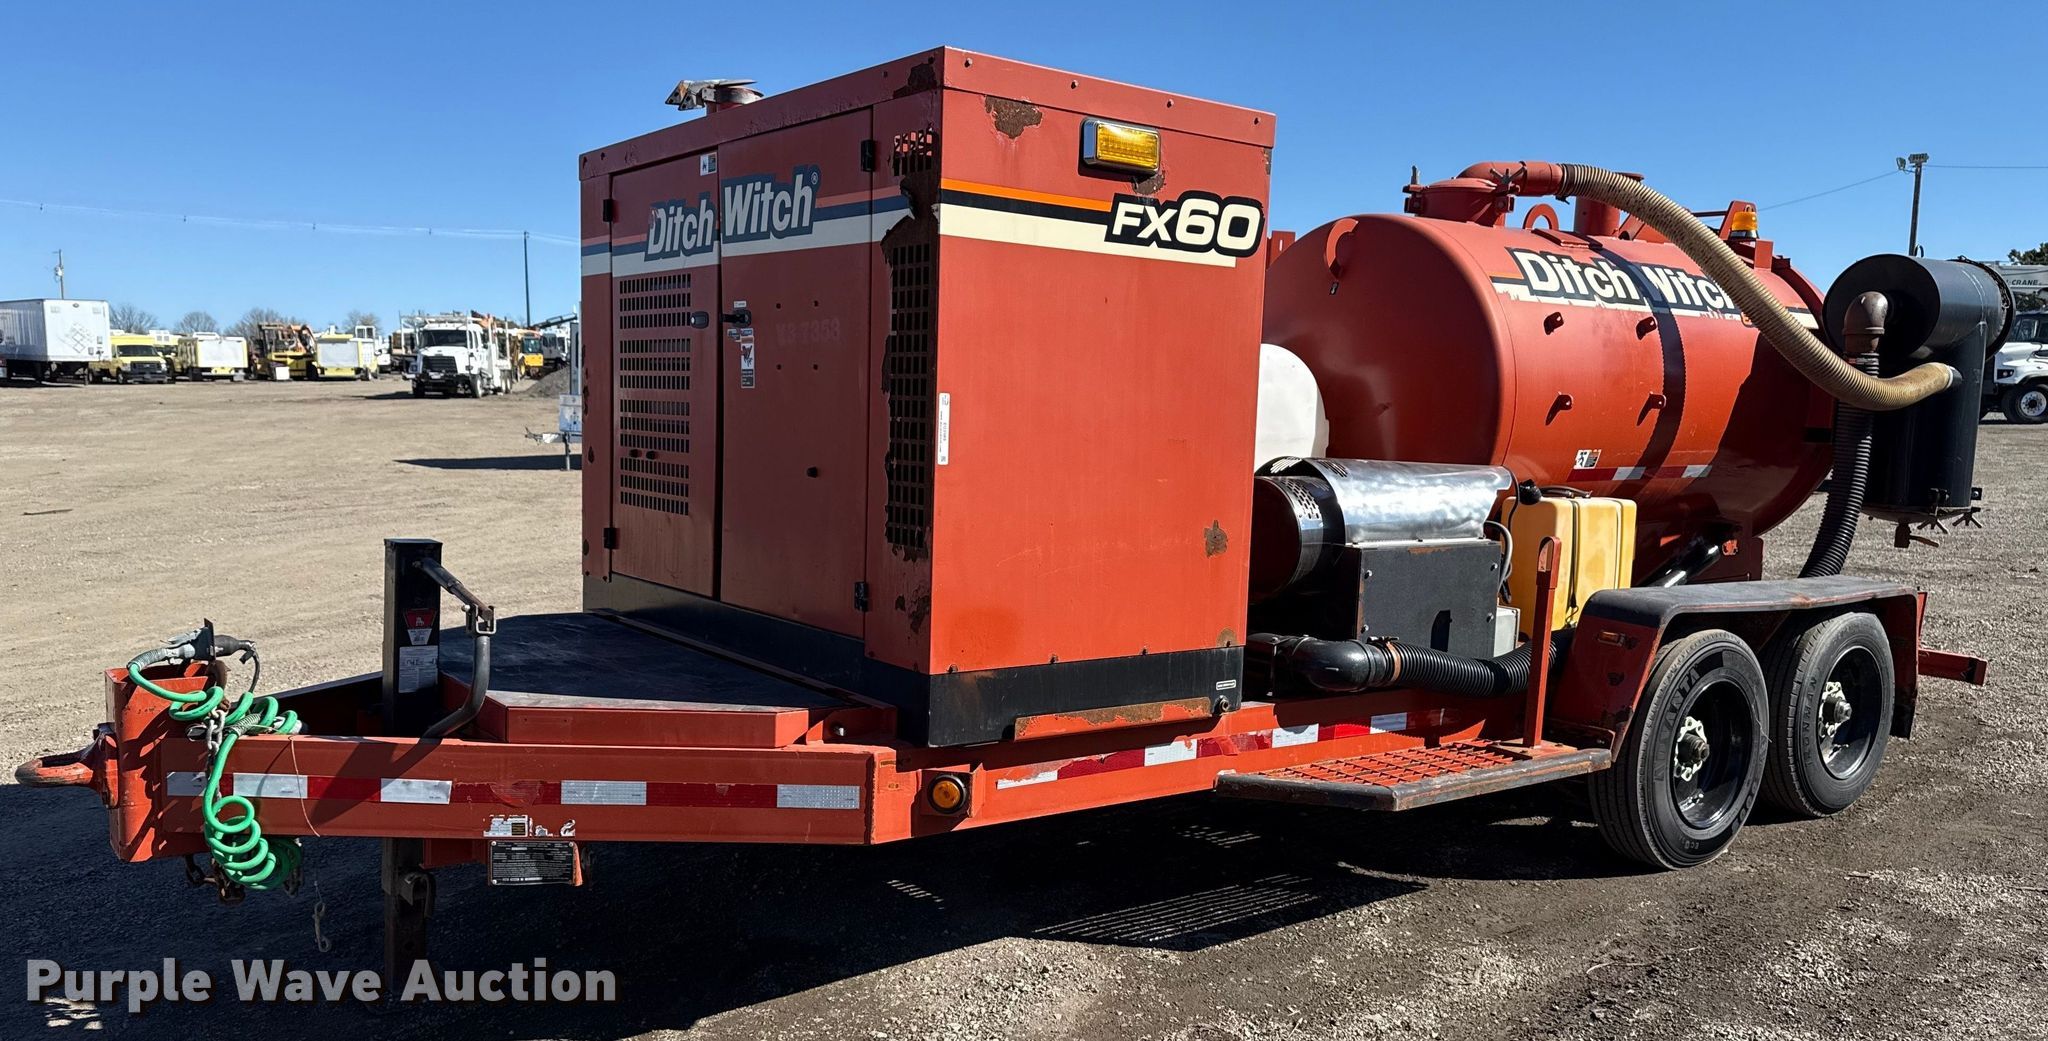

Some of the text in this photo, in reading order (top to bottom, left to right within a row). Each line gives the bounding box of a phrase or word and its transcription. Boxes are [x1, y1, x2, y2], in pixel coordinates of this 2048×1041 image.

[648, 199, 714, 255] Ditch
[1112, 198, 1261, 250] FX60
[1514, 251, 1641, 300] Ditch
